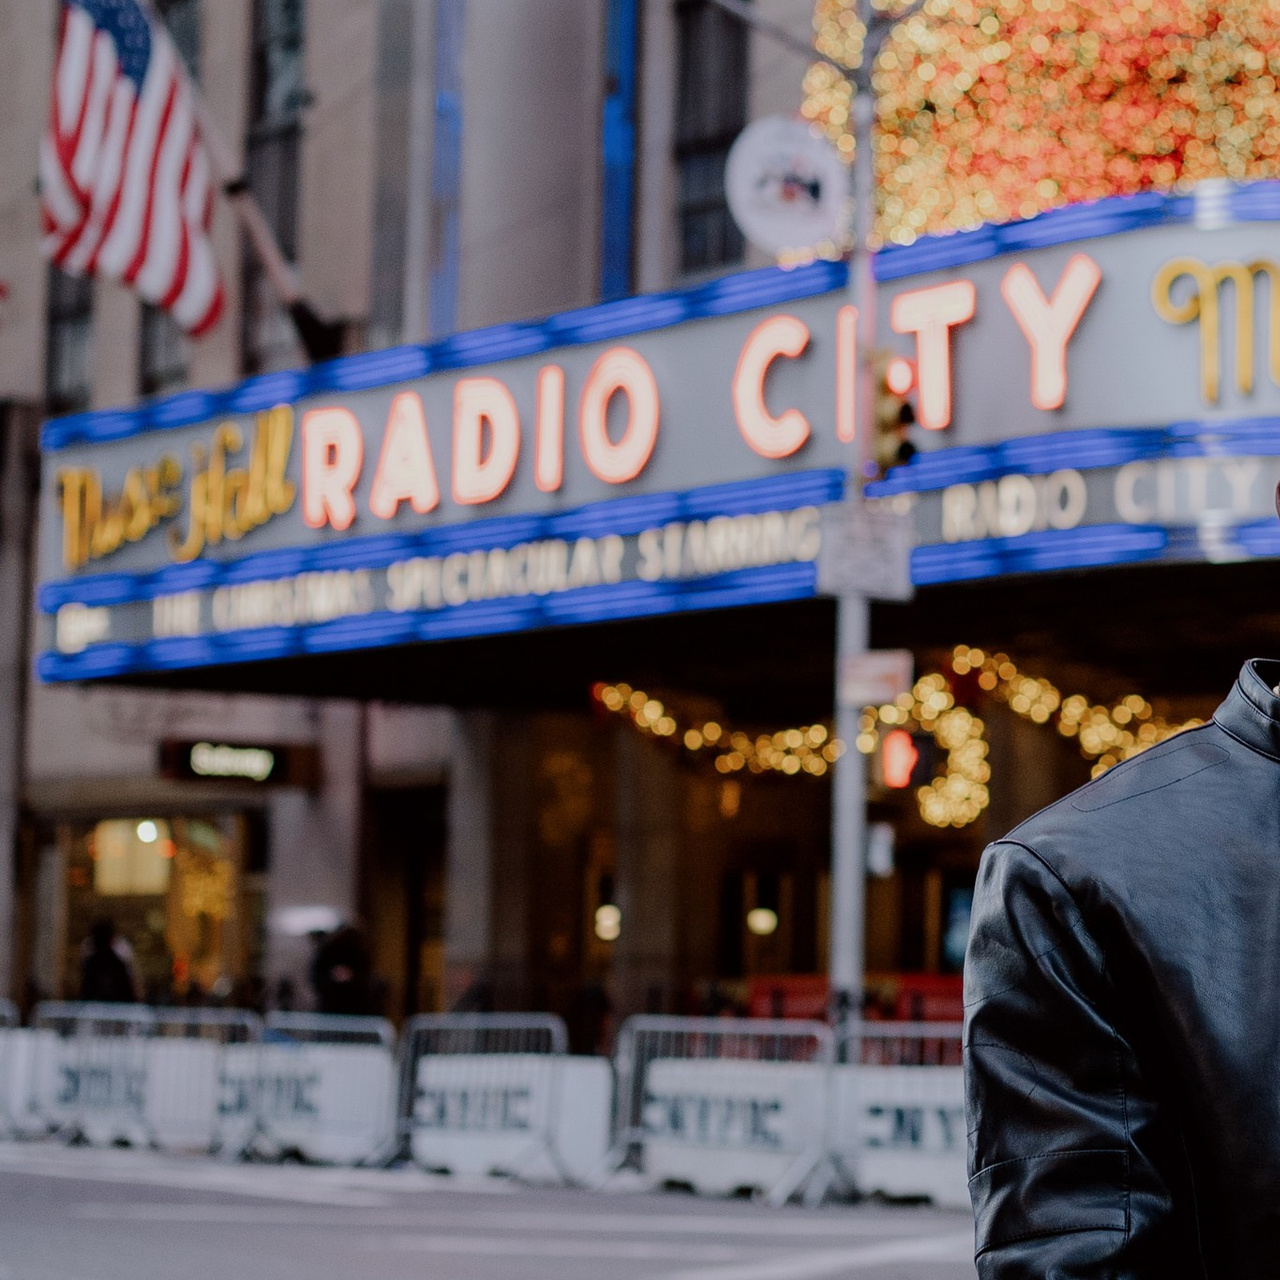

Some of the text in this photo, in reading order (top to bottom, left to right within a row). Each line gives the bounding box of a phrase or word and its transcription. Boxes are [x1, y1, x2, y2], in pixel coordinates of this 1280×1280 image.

[302, 347, 660, 530] RADIO
[732, 253, 1102, 459] CITY
[941, 460, 1262, 543] RADIO CITY
[386, 533, 625, 613] SPECTACULAR
